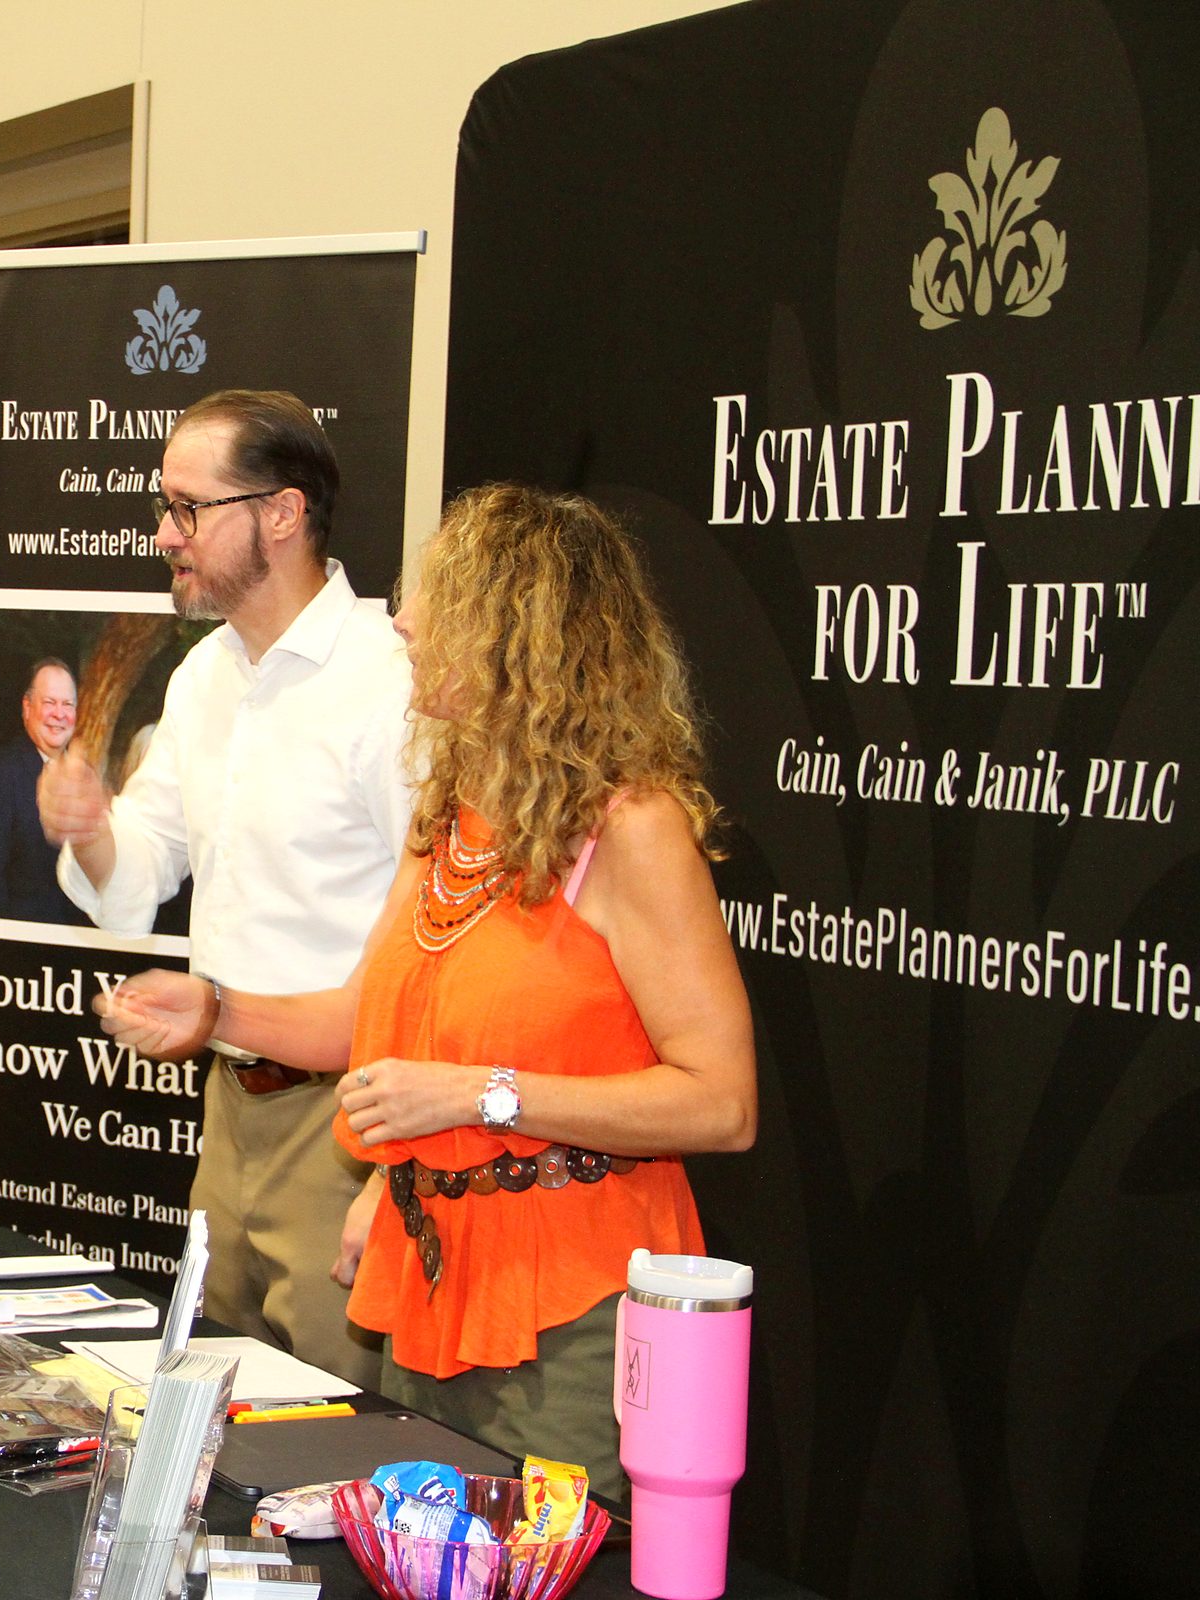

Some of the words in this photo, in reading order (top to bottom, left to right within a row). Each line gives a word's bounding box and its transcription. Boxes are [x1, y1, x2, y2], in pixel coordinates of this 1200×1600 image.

[1, 400, 79, 441] ESTATE
[59, 465, 102, 497] Cain,
[106, 466, 145, 493] Cain
[148, 467, 162, 493] &
[708, 393, 910, 526] ESTATE
[8, 526, 171, 558] www.EstatePlan
[810, 583, 920, 686] FOR
[776, 736, 847, 806] Cain,
[857, 740, 927, 804] Cain
[934, 748, 960, 807] &
[966, 749, 1071, 827] Janik,
[1080, 757, 1180, 825] PLLC
[77, 1036, 199, 1098] What
[41, 1101, 92, 1141] We
[99, 1109, 161, 1153] Can
[61, 1183, 127, 1216] Estate
[88, 1244, 115, 1264] an
